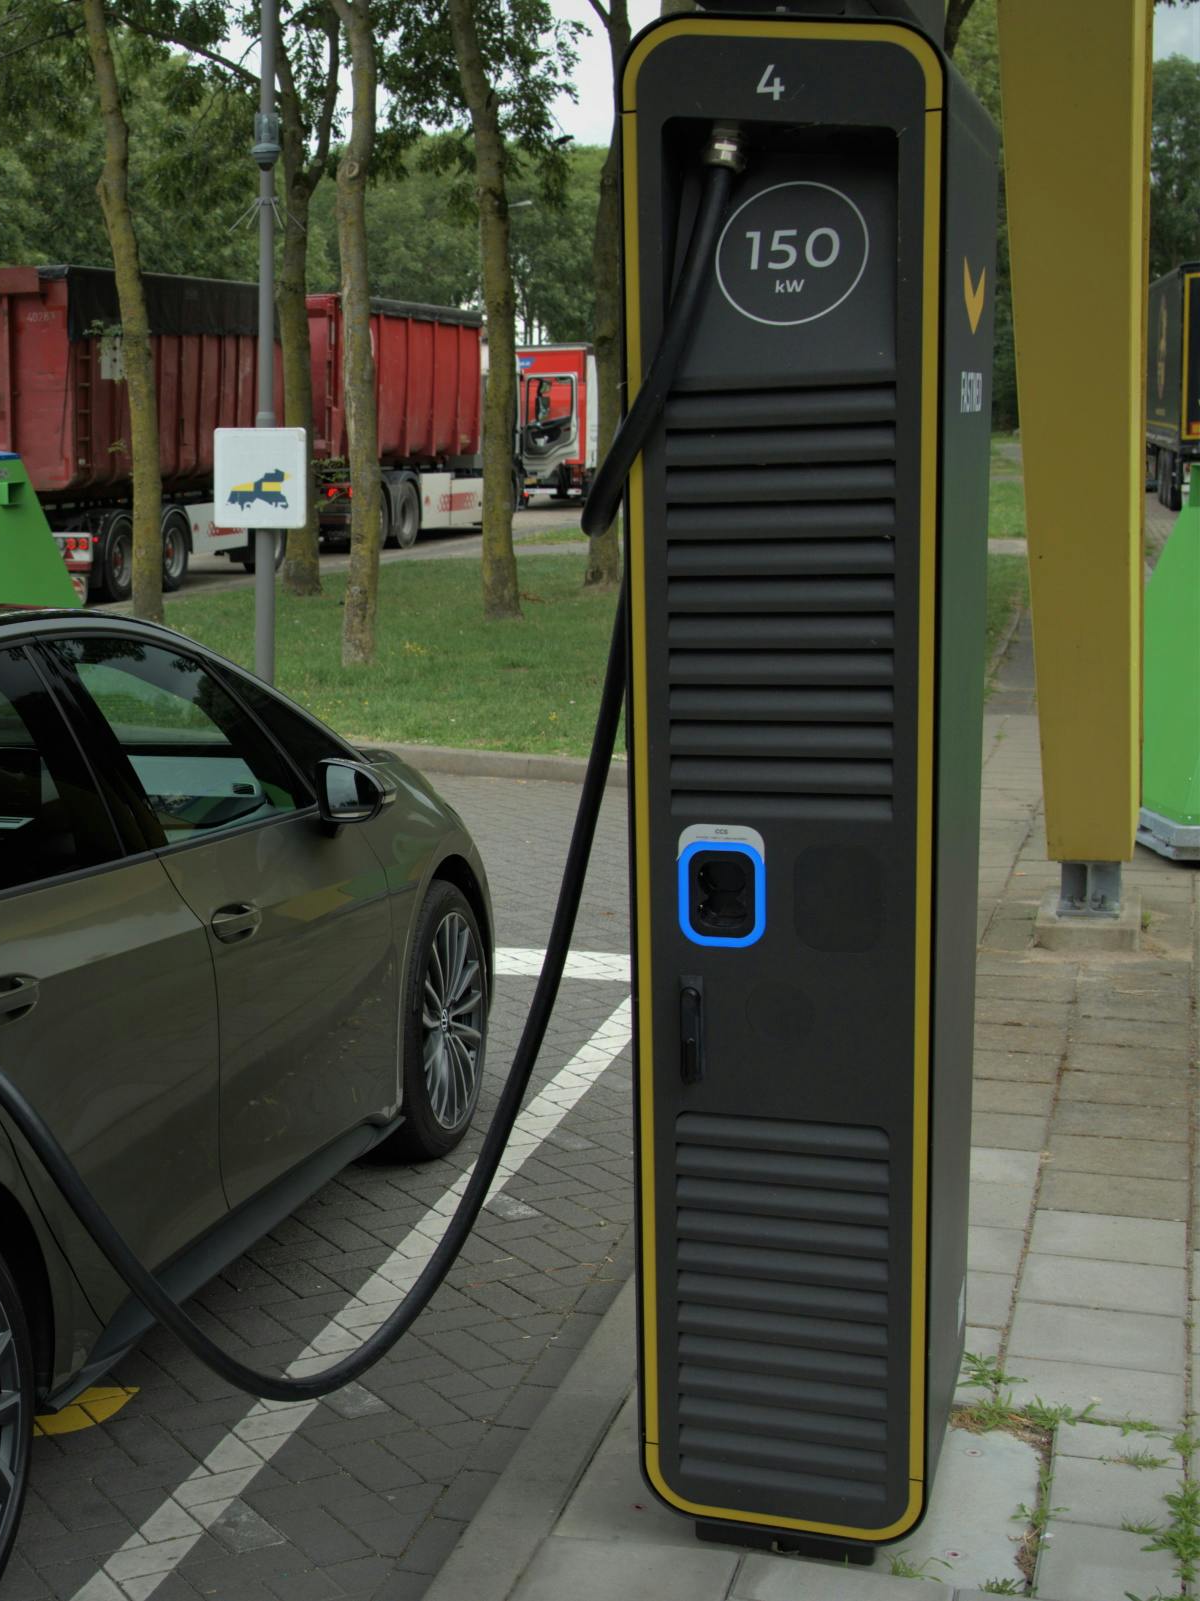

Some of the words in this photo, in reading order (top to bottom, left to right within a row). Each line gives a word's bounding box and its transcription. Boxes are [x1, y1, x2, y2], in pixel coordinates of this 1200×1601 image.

[756, 64, 786, 101] 4
[745, 227, 841, 271] 150
[774, 279, 805, 294] kW
